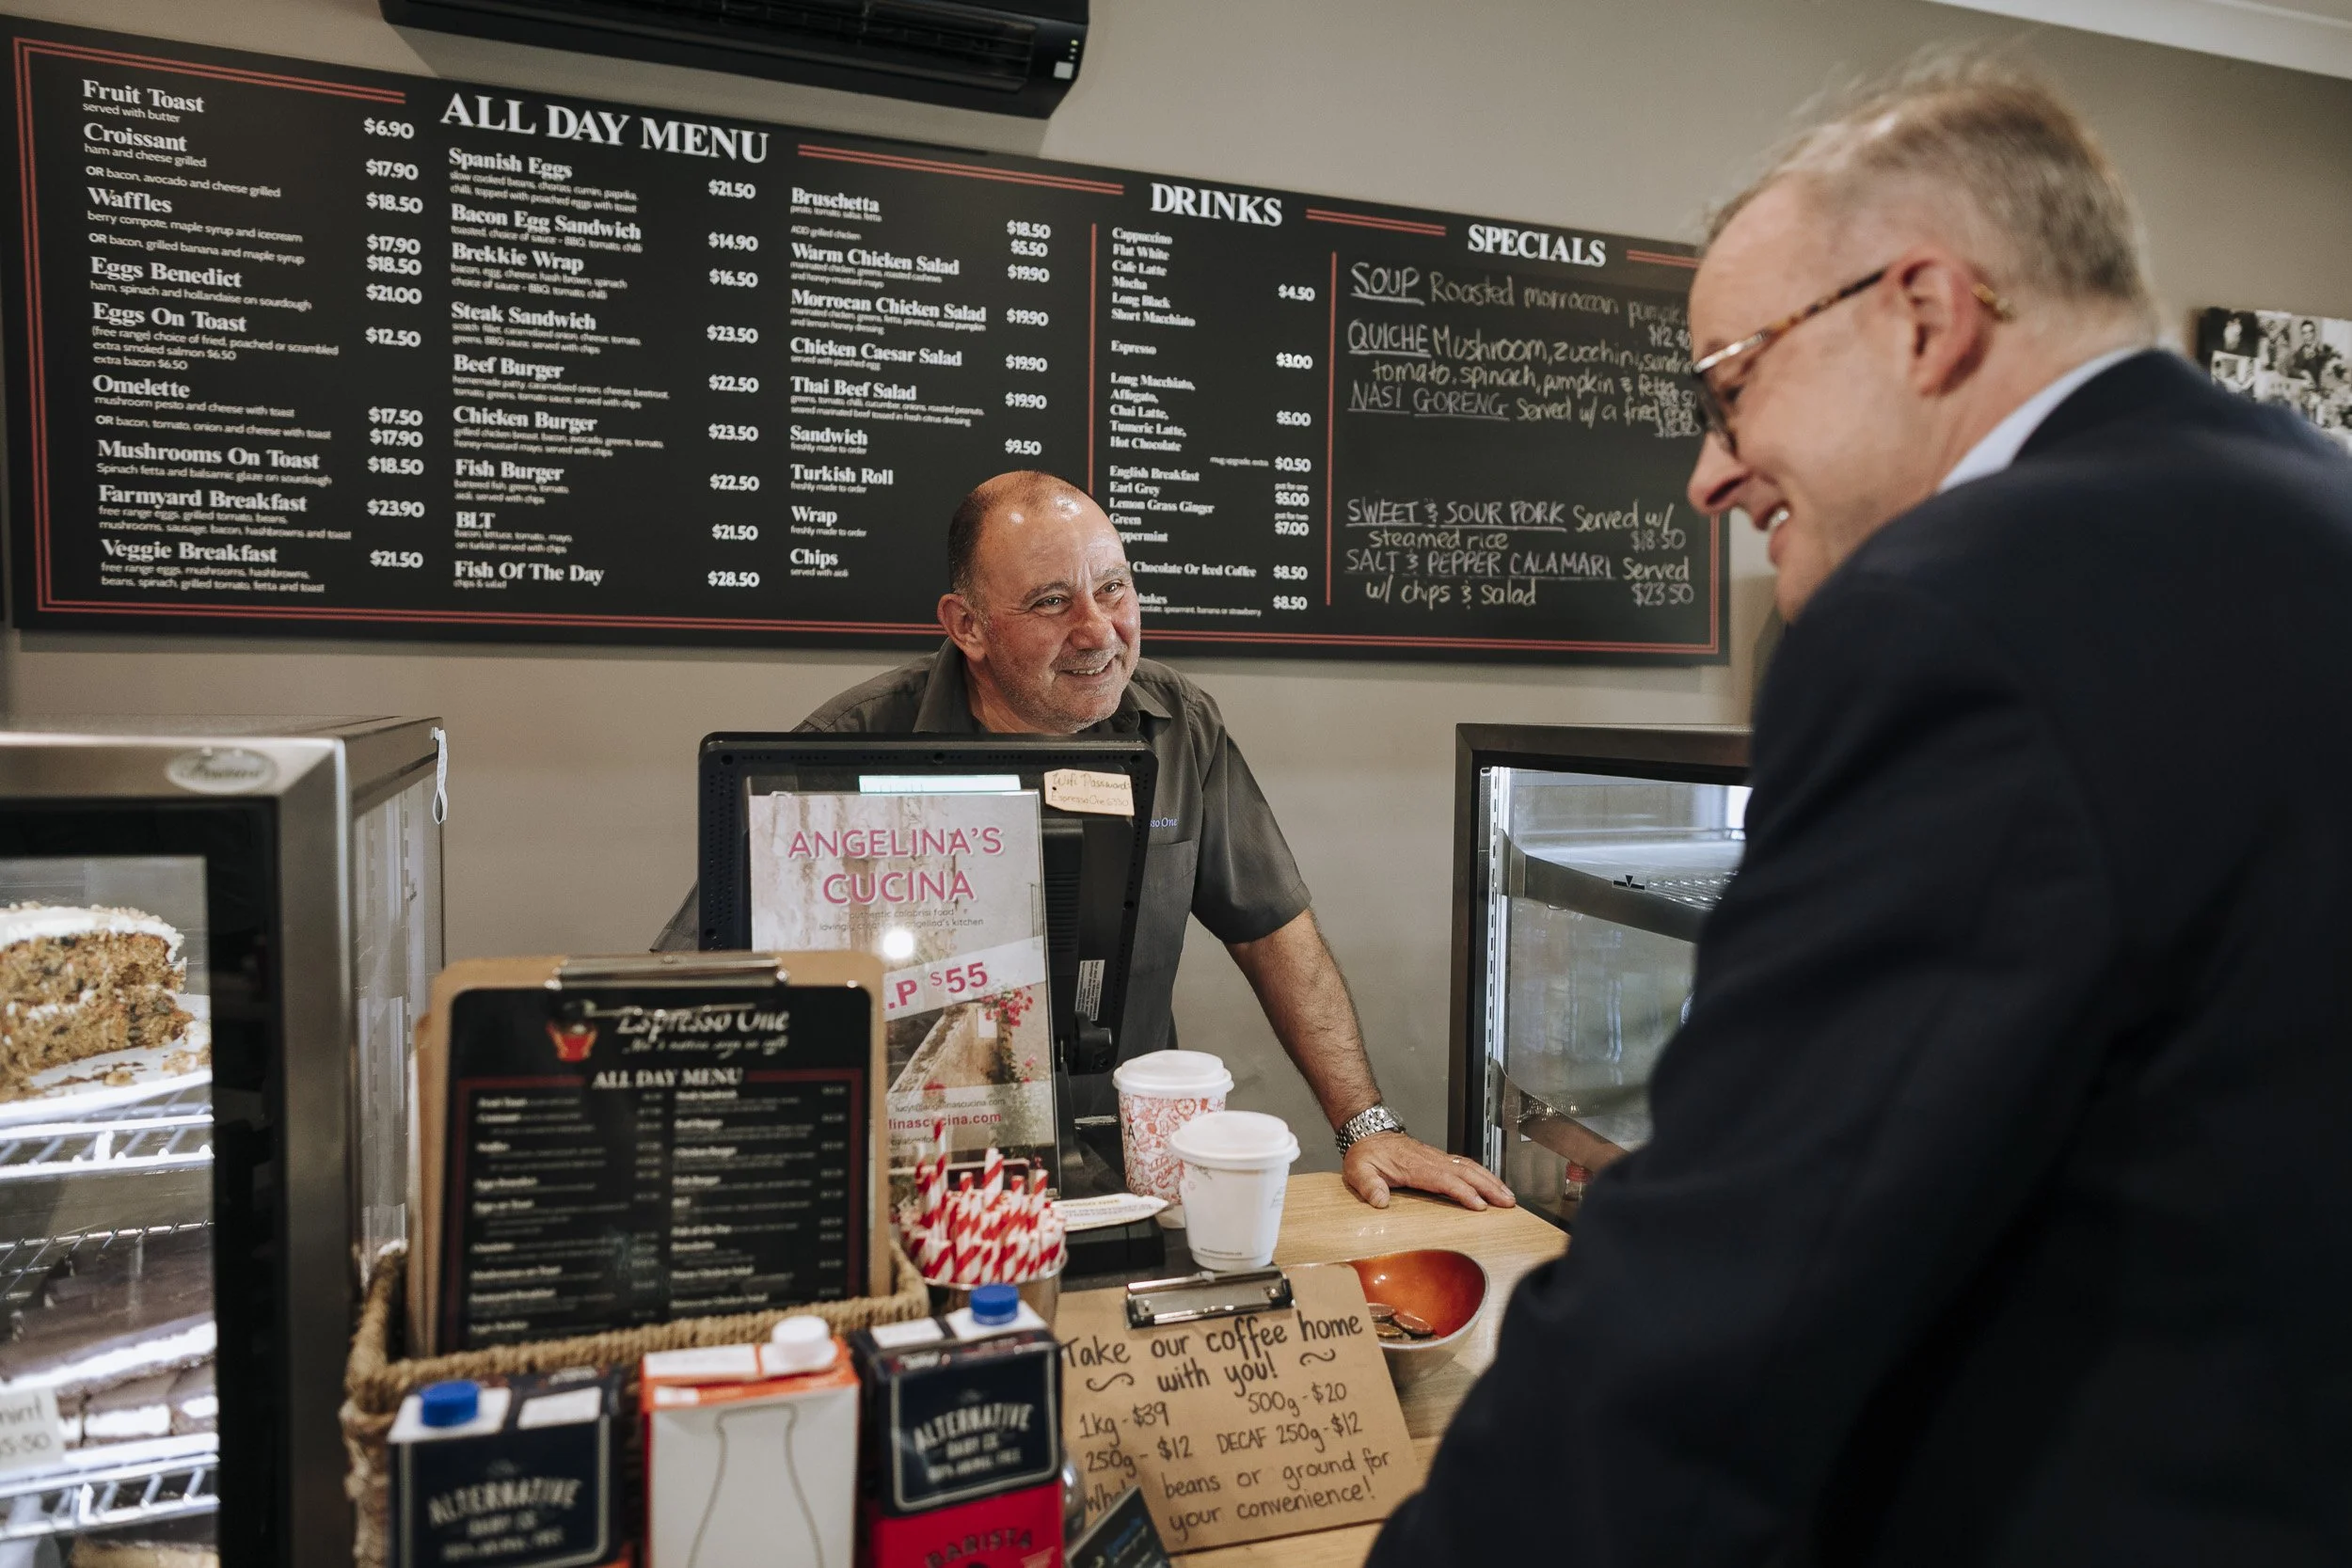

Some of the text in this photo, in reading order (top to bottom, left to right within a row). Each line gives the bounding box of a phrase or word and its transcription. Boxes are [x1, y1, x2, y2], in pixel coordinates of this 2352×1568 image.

[82, 80, 204, 113] Fruit Toast
[84, 103, 181, 123] served with butter
[84, 122, 187, 151] Croissant
[364, 117, 415, 139] $6.90
[440, 93, 771, 164] ALL DAY MENU
[85, 144, 206, 168] ham and cheese grilled
[449, 148, 573, 181] Spanish Eggs
[86, 166, 104, 177] OR
[144, 172, 187, 187] avocado
[190, 178, 210, 190] and
[366, 159, 419, 181] $17.90
[87, 187, 172, 214] Waffles
[366, 192, 422, 214] $18.50
[791, 187, 880, 213] Bruschetta
[1151, 182, 1282, 227] DRINKS
[451, 203, 642, 241] Bacon Egg Sandwich
[1468, 224, 1606, 267] SPECIALS
[367, 255, 421, 276] $18.50
[453, 243, 584, 275] Brekkie Wrap
[791, 242, 960, 276] Warm Chicken Salad
[90, 257, 242, 288] Eggs Benedict
[1350, 261, 1515, 307] SOUP Roasted
[1278, 284, 1315, 302] $4.50
[93, 302, 246, 333] Eggs On Toast
[452, 301, 596, 331] Steak Sandwich
[876, 297, 987, 323] Chicken Salad
[366, 327, 421, 348] $12.50
[707, 325, 758, 343] $23.50
[1347, 318, 1431, 352] QUICHE
[790, 337, 962, 367] Chicken Caesar Salad
[1276, 352, 1313, 370] $3.00
[453, 355, 564, 382] Beef Burger
[93, 374, 190, 398] Omelette
[708, 374, 758, 393] $22.50
[790, 375, 916, 401] Thai Beef Salad
[1351, 379, 1403, 410] NASI
[1413, 387, 1506, 416] GORENG
[1516, 396, 1571, 422] Served
[369, 406, 422, 427] $17.50
[453, 405, 597, 435] Chicken Burger
[708, 423, 758, 441] $23.50
[790, 425, 867, 446] Sandwich
[98, 439, 320, 469] Mushrooms On Toast
[368, 456, 423, 475] $18.50
[1275, 456, 1311, 472] $0.50
[454, 459, 564, 484] Fish Burger
[709, 474, 759, 491] $22.50
[790, 464, 894, 484] Turkish Roll
[1152, 467, 1200, 482] Breakfast
[99, 484, 307, 513] Farmyard Breakfast
[1135, 483, 1161, 498] Grey
[367, 499, 424, 517] $23.90
[455, 511, 496, 530] BLT
[791, 506, 837, 527] Wrap
[1110, 514, 1141, 526] Green
[1346, 497, 1639, 532] SWEET SOUR PORK Served
[1275, 521, 1309, 535] $7.00
[1369, 528, 1508, 549] steamed rice
[102, 539, 278, 563] Veggie Breakfast
[790, 548, 838, 569] Chips
[454, 561, 604, 587] Fish Of The Day
[1184, 563, 1200, 575] Or
[1273, 565, 1308, 580] $8.50
[1346, 549, 1689, 581] SALT PEPPER CALAMARI Served
[1273, 595, 1307, 610] $8.50
[1401, 578, 1536, 610] chips salad
[1053, 772, 1077, 787] Wifi
[1161, 817, 1178, 827] One
[787, 826, 1004, 860] ANGELINA'S
[822, 871, 976, 906] CUCINA
[591, 1067, 743, 1089] ALL DAY MENU
[1063, 1309, 1362, 1370] Take our coffee home
[1157, 1352, 1278, 1397] with you!
[1248, 1382, 1347, 1418] 500g $20
[1080, 1401, 1170, 1448] 1kg $39
[1216, 1426, 1267, 1454] DECAF
[1331, 1411, 1362, 1437] $12
[1157, 1435, 1193, 1462] $12
[1162, 1447, 1391, 1500] beans or ground for
[1169, 1507, 1221, 1543] your
[1237, 1478, 1375, 1521] convenience!
